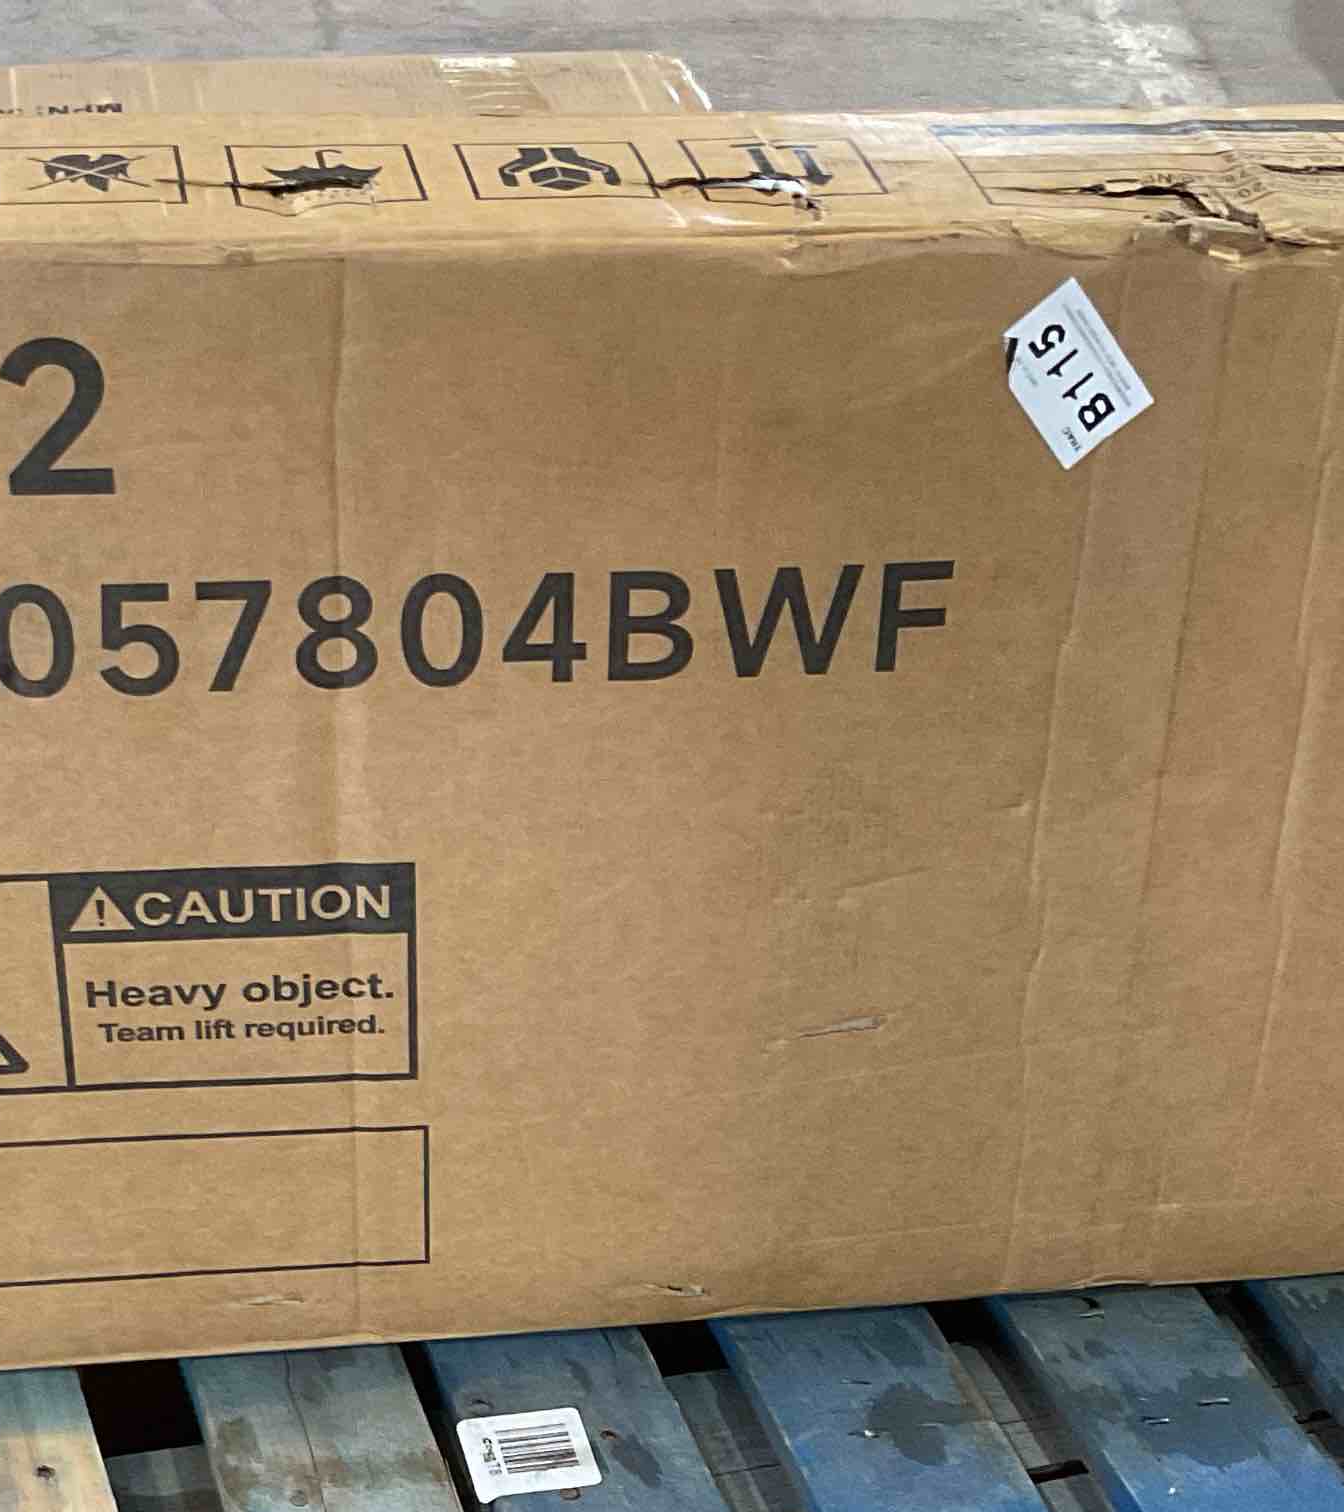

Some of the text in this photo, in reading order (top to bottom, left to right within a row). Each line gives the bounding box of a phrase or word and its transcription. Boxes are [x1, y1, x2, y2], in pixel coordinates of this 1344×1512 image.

[1027, 323, 1116, 433] B115
[134, 883, 391, 928] CAUTION
[85, 972, 395, 1012] Heavy object.
[97, 1013, 385, 1044] Team lift required.
